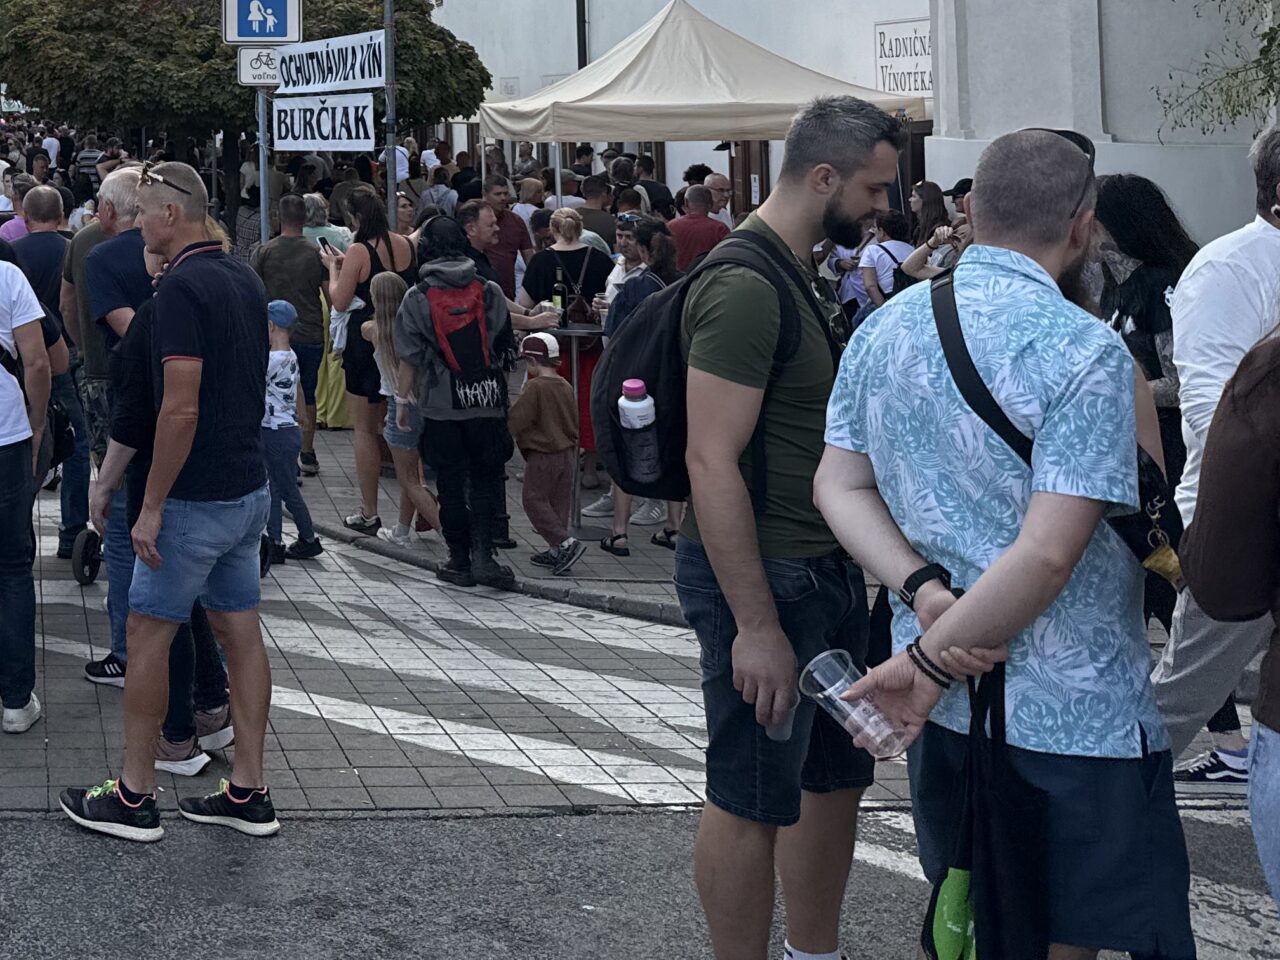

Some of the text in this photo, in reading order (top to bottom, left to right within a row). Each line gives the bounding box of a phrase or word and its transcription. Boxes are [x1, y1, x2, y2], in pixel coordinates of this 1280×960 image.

[252, 73, 277, 81] voľno
[280, 35, 382, 88] OCHUTNÁVKA VÍN
[277, 98, 372, 141] BURČIAK
